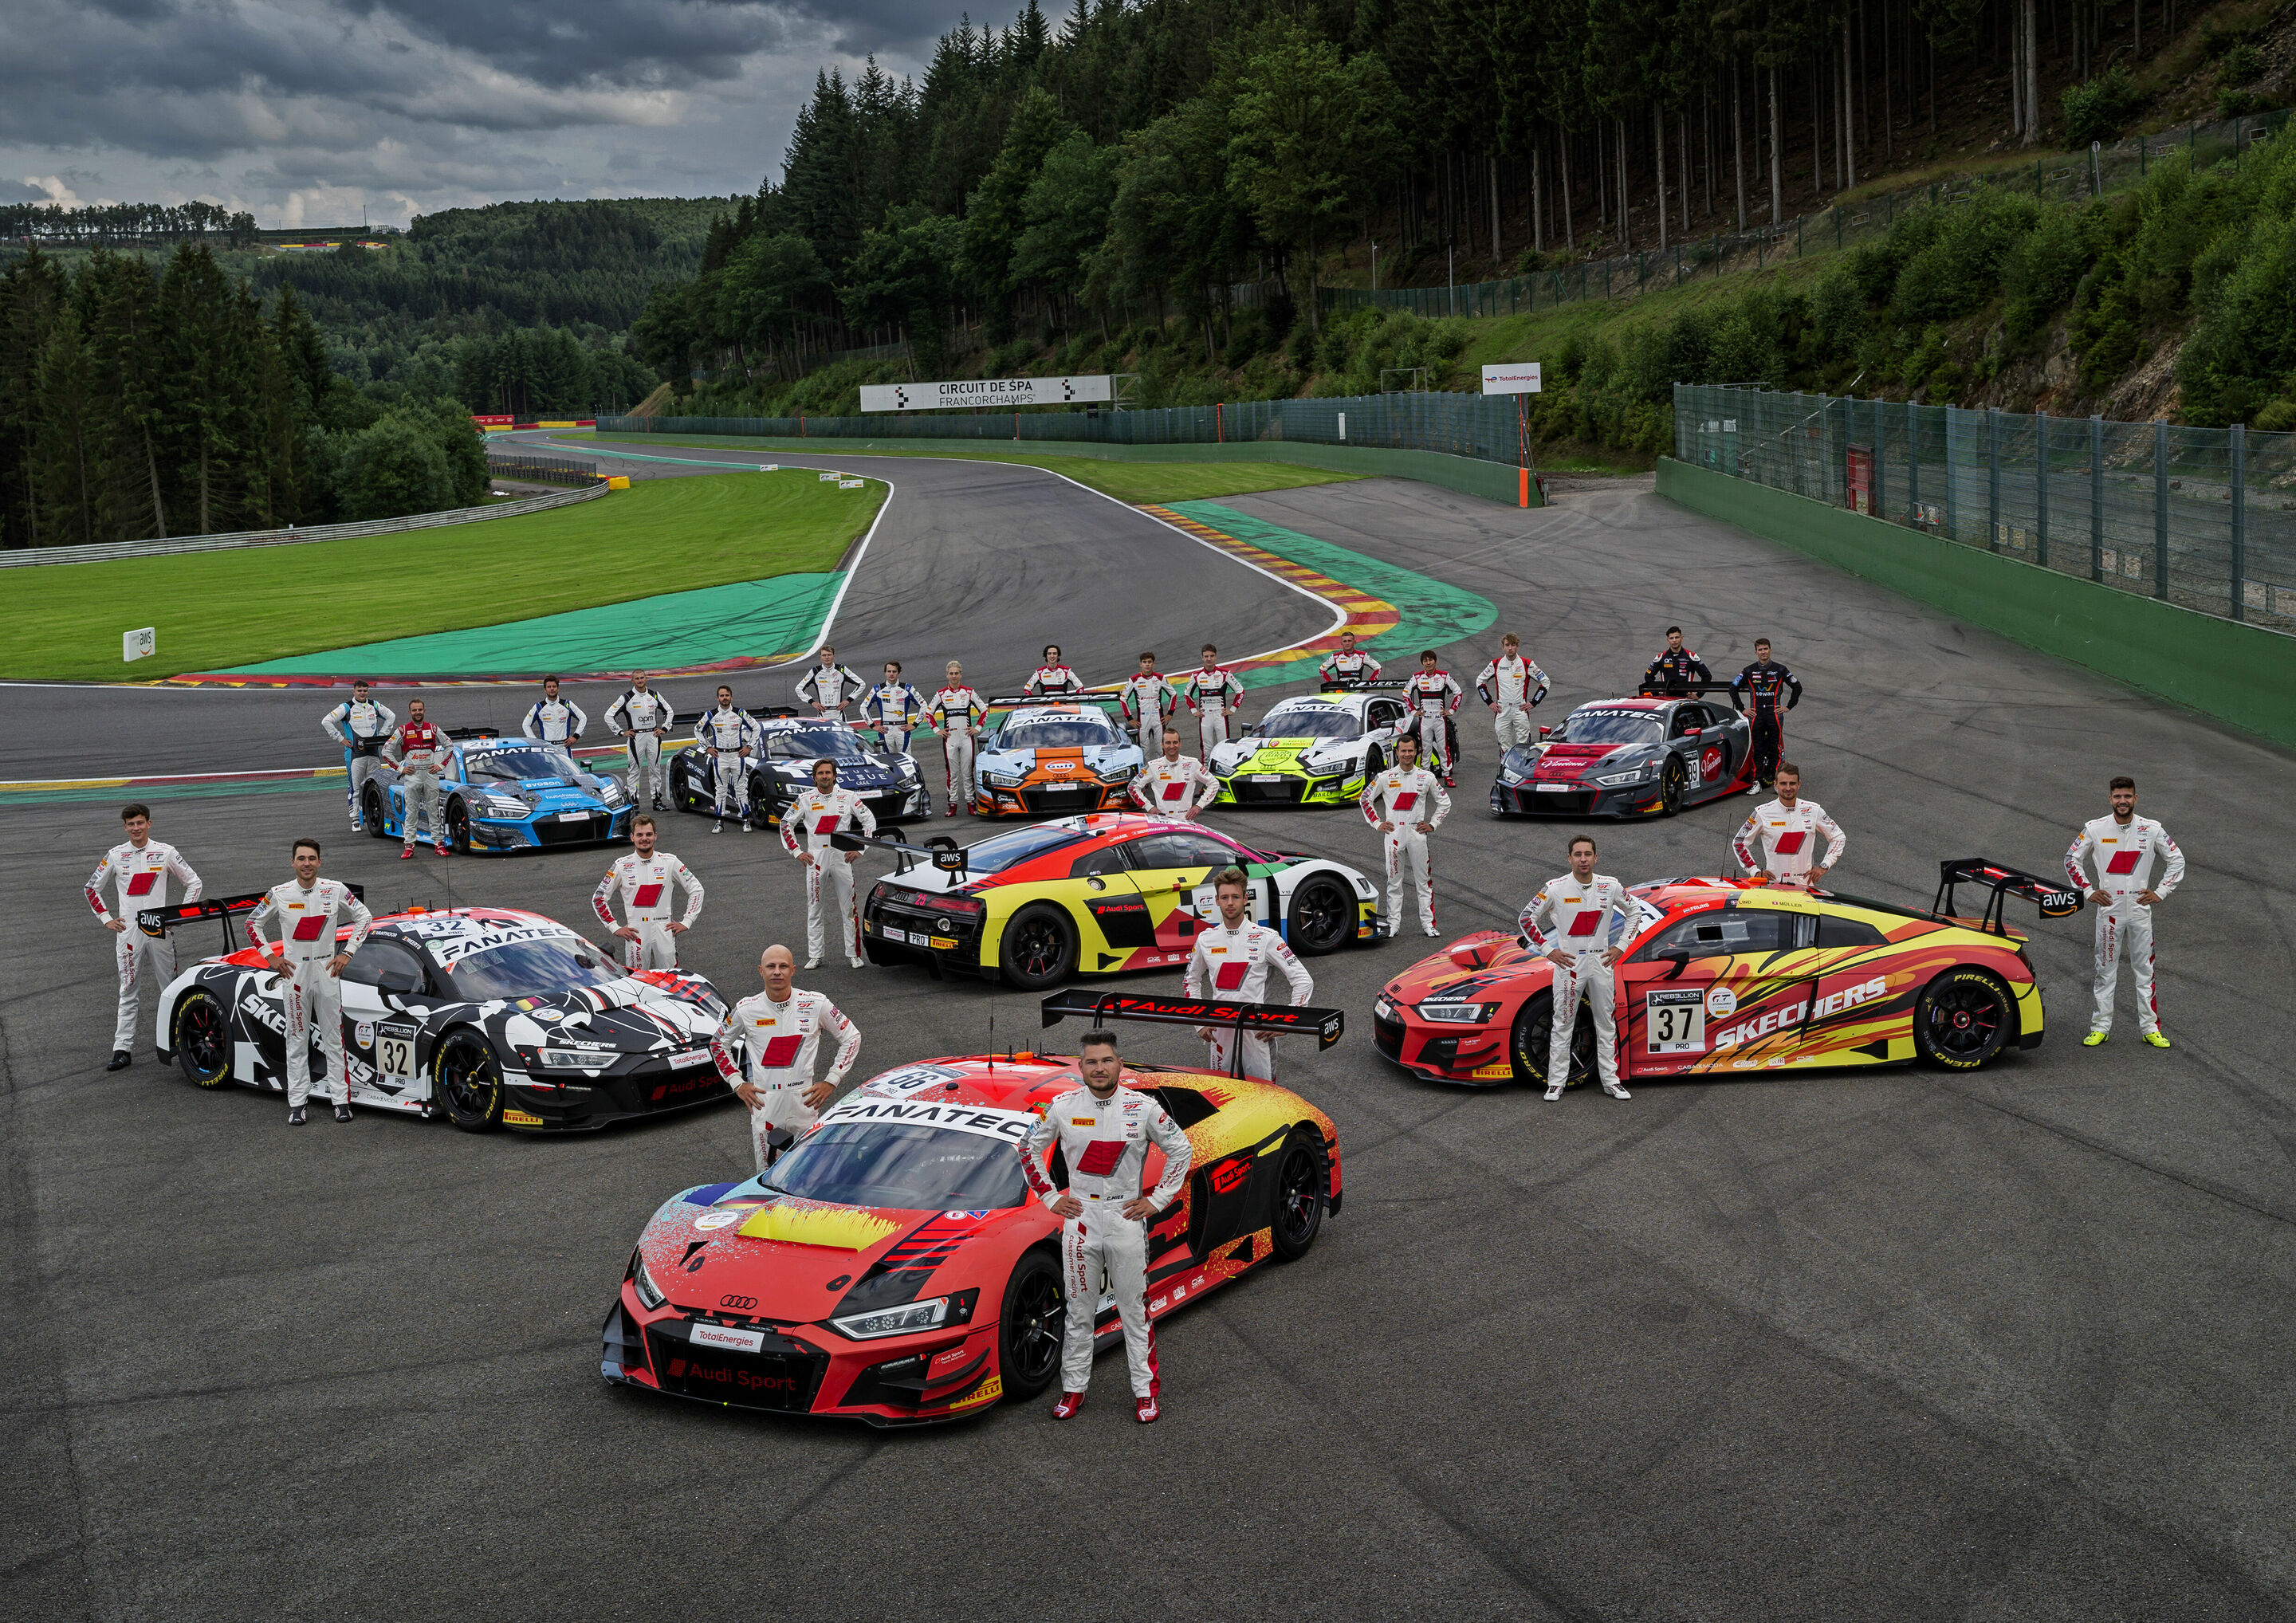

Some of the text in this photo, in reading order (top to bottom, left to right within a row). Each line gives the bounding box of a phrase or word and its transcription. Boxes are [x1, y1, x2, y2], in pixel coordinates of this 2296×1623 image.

[939, 380, 1033, 395] CIRCUIT DE SPA
[939, 394, 1034, 407] FRANCORCHAMPS
[140, 631, 151, 645] aws
[1011, 717, 1102, 727] FANATEC
[1567, 709, 1659, 721] FANATEC
[769, 726, 855, 739] FANATEC
[466, 747, 556, 764] FANATEC
[941, 853, 961, 863] aws
[915, 894, 928, 906] 25
[2042, 893, 2077, 906] aws
[1123, 903, 1144, 912] Sport
[140, 913, 161, 927] aws
[427, 921, 466, 932] 32
[442, 926, 576, 961] FANATEC
[912, 934, 926, 945] PRO
[1954, 974, 2000, 992] PIRELLI
[1135, 1001, 1206, 1015] Audi
[1715, 975, 1886, 1051] SKECHERS
[295, 1012, 305, 1032] Sport
[1324, 1017, 1339, 1035] aws
[1657, 1008, 1693, 1041] 37
[383, 1025, 413, 1035] REBELLION
[559, 1039, 617, 1048] SKECHERS
[383, 1040, 408, 1076] 32
[435, 1043, 447, 1083] PIRELLI
[673, 1052, 708, 1064] TotalEnergies
[1476, 1066, 1511, 1075] PIRELLI
[669, 1074, 723, 1094] Audi Spo
[888, 1071, 940, 1091] 66
[504, 1110, 540, 1123] PIRELLI
[826, 1103, 1030, 1138] FANATEC
[1221, 1163, 1251, 1185] Audi Sport
[952, 1210, 961, 1219] E
[1078, 1262, 1088, 1293] Sport
[699, 1330, 754, 1348] TotalEnergies
[1094, 1330, 1105, 1339] Sport
[690, 1363, 796, 1392] Audi Sport
